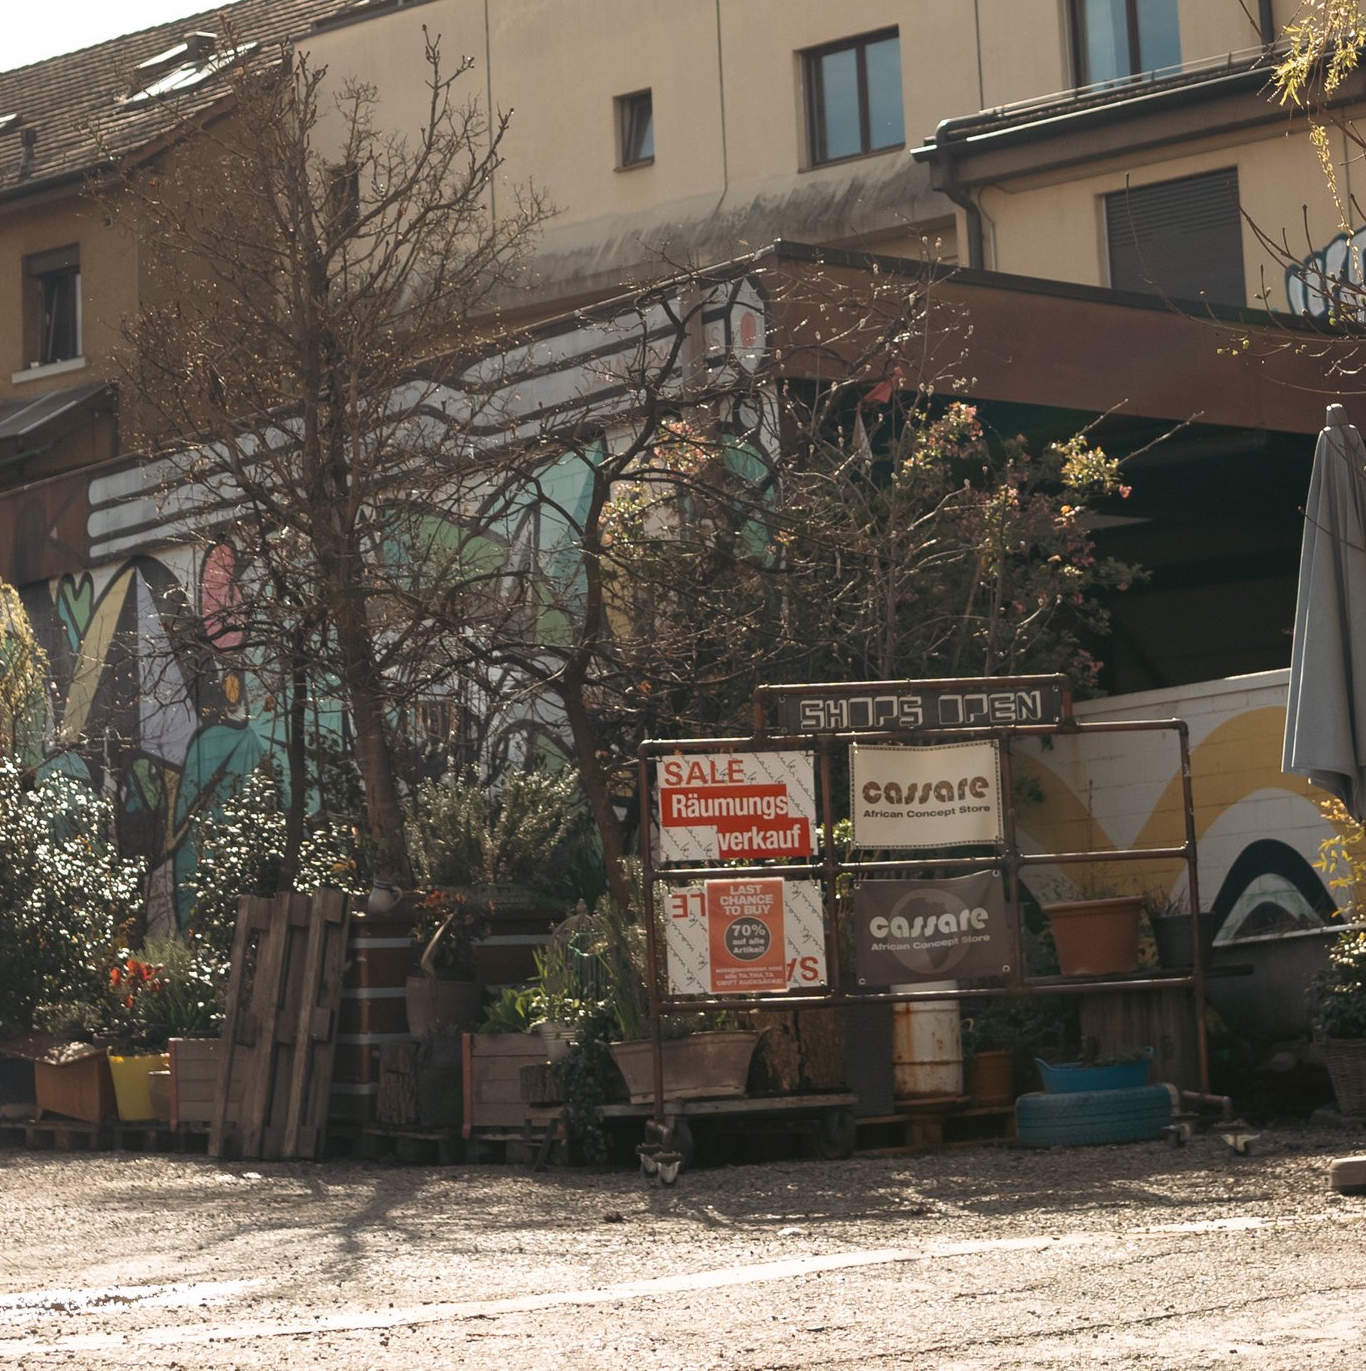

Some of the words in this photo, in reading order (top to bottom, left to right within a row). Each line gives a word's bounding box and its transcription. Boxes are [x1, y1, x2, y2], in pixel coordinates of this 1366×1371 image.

[799, 696, 923, 730] SHOPS
[938, 690, 1042, 725] OPEN
[664, 759, 745, 786] SALE
[862, 775, 990, 805] cassare
[671, 793, 789, 819] Räumungs
[863, 808, 904, 818] African
[906, 808, 956, 819] Concept
[959, 805, 991, 814] Store
[717, 824, 801, 851] verkauf
[730, 884, 763, 895] LAST
[719, 894, 774, 906] CHANCE
[723, 906, 741, 916] TO
[744, 905, 771, 916] BUY
[731, 923, 766, 937] 70%
[869, 907, 989, 938] cassare
[748, 937, 765, 945] alle
[871, 942, 911, 951] African
[913, 938, 959, 950] Concept
[961, 934, 991, 944] Store
